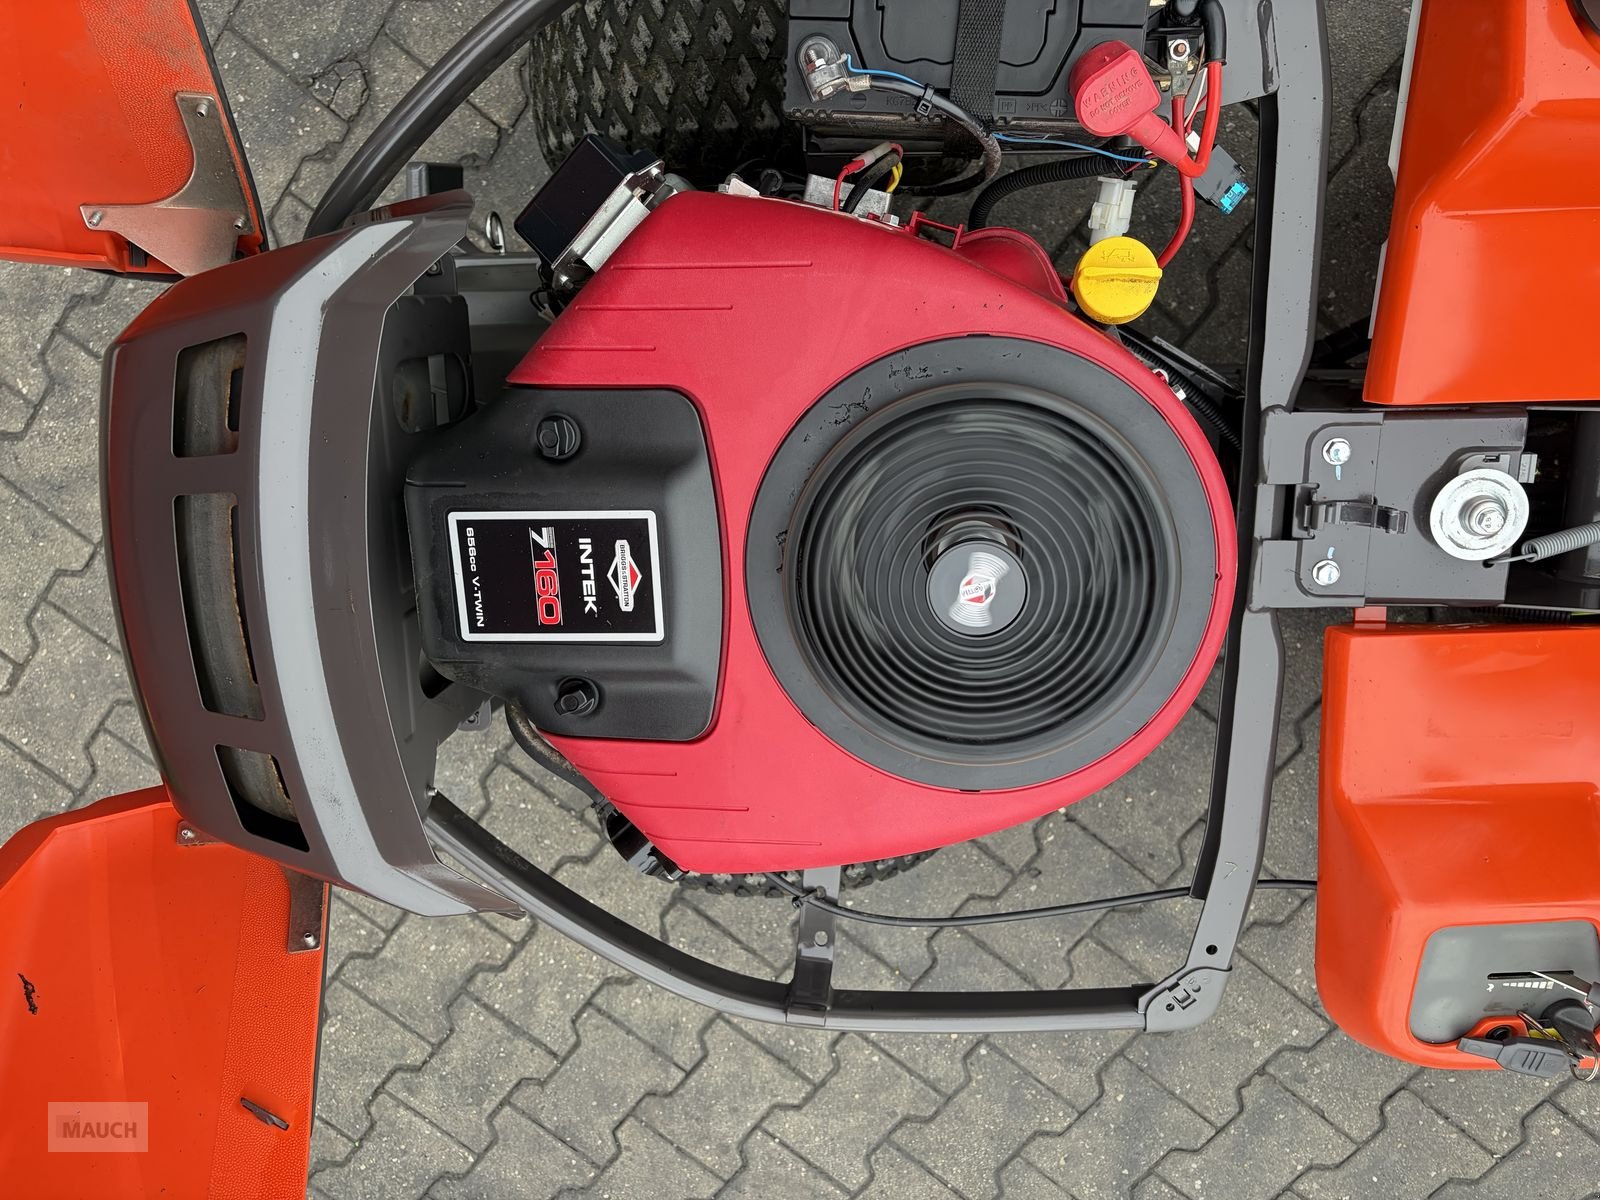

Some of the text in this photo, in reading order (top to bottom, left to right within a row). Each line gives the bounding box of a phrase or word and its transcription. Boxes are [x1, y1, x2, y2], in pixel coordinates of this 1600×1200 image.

[1082, 66, 1138, 109] WARNING
[1089, 80, 1144, 119] DO NOT REMOVE
[1109, 98, 1132, 116] COVER
[466, 527, 485, 628] 656cc V-TWIN
[578, 537, 598, 615] INTEK
